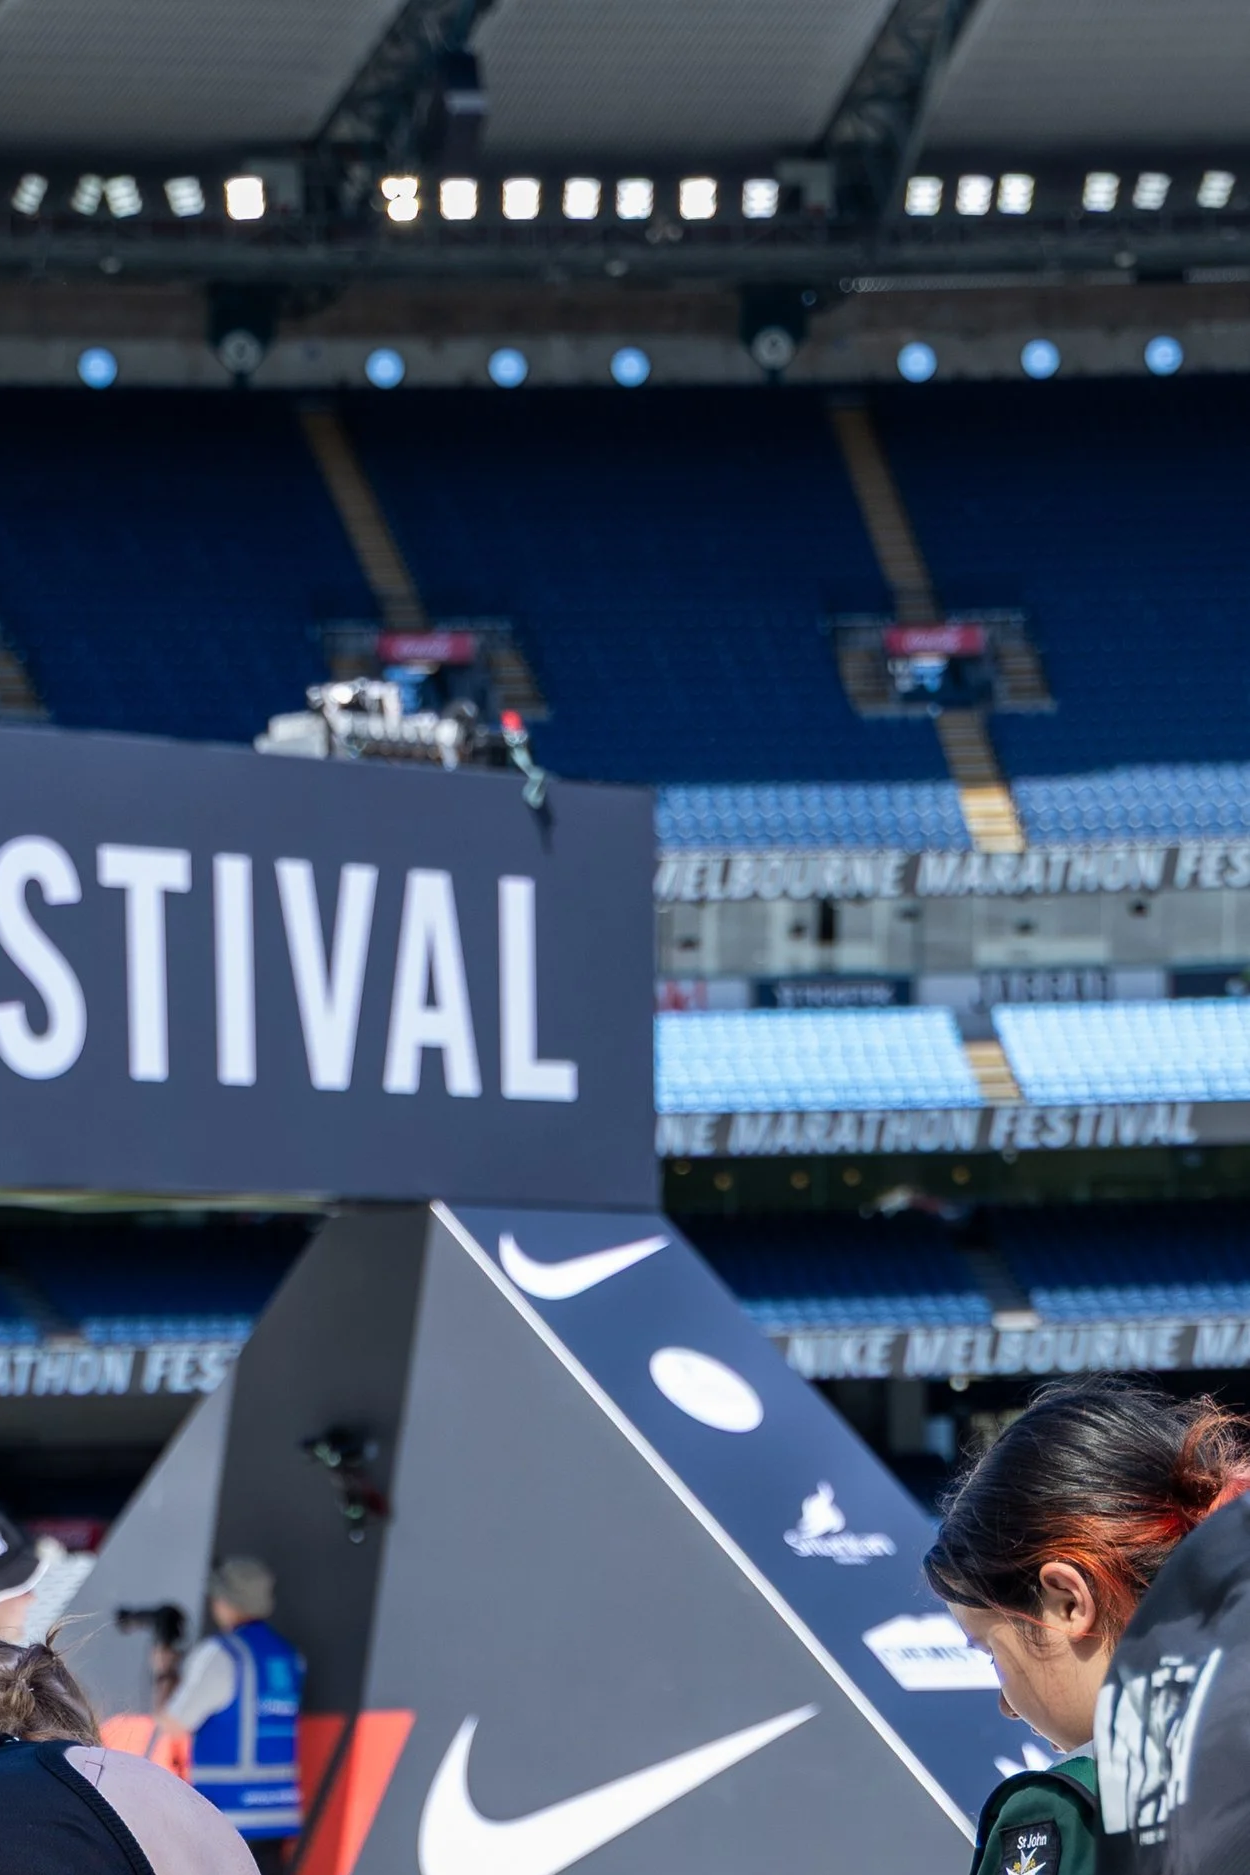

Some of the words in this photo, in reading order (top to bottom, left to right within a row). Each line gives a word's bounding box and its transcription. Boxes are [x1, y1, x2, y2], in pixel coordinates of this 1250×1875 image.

[914, 850, 1168, 897] MARATHON
[726, 1107, 982, 1157] MARATHON
[988, 1103, 1199, 1151] FESTIVAL
[784, 1329, 899, 1378] NIKE
[902, 1325, 1187, 1378] MELBOURNE
[1016, 1834, 1027, 1850] St
[1027, 1833, 1047, 1849] John
